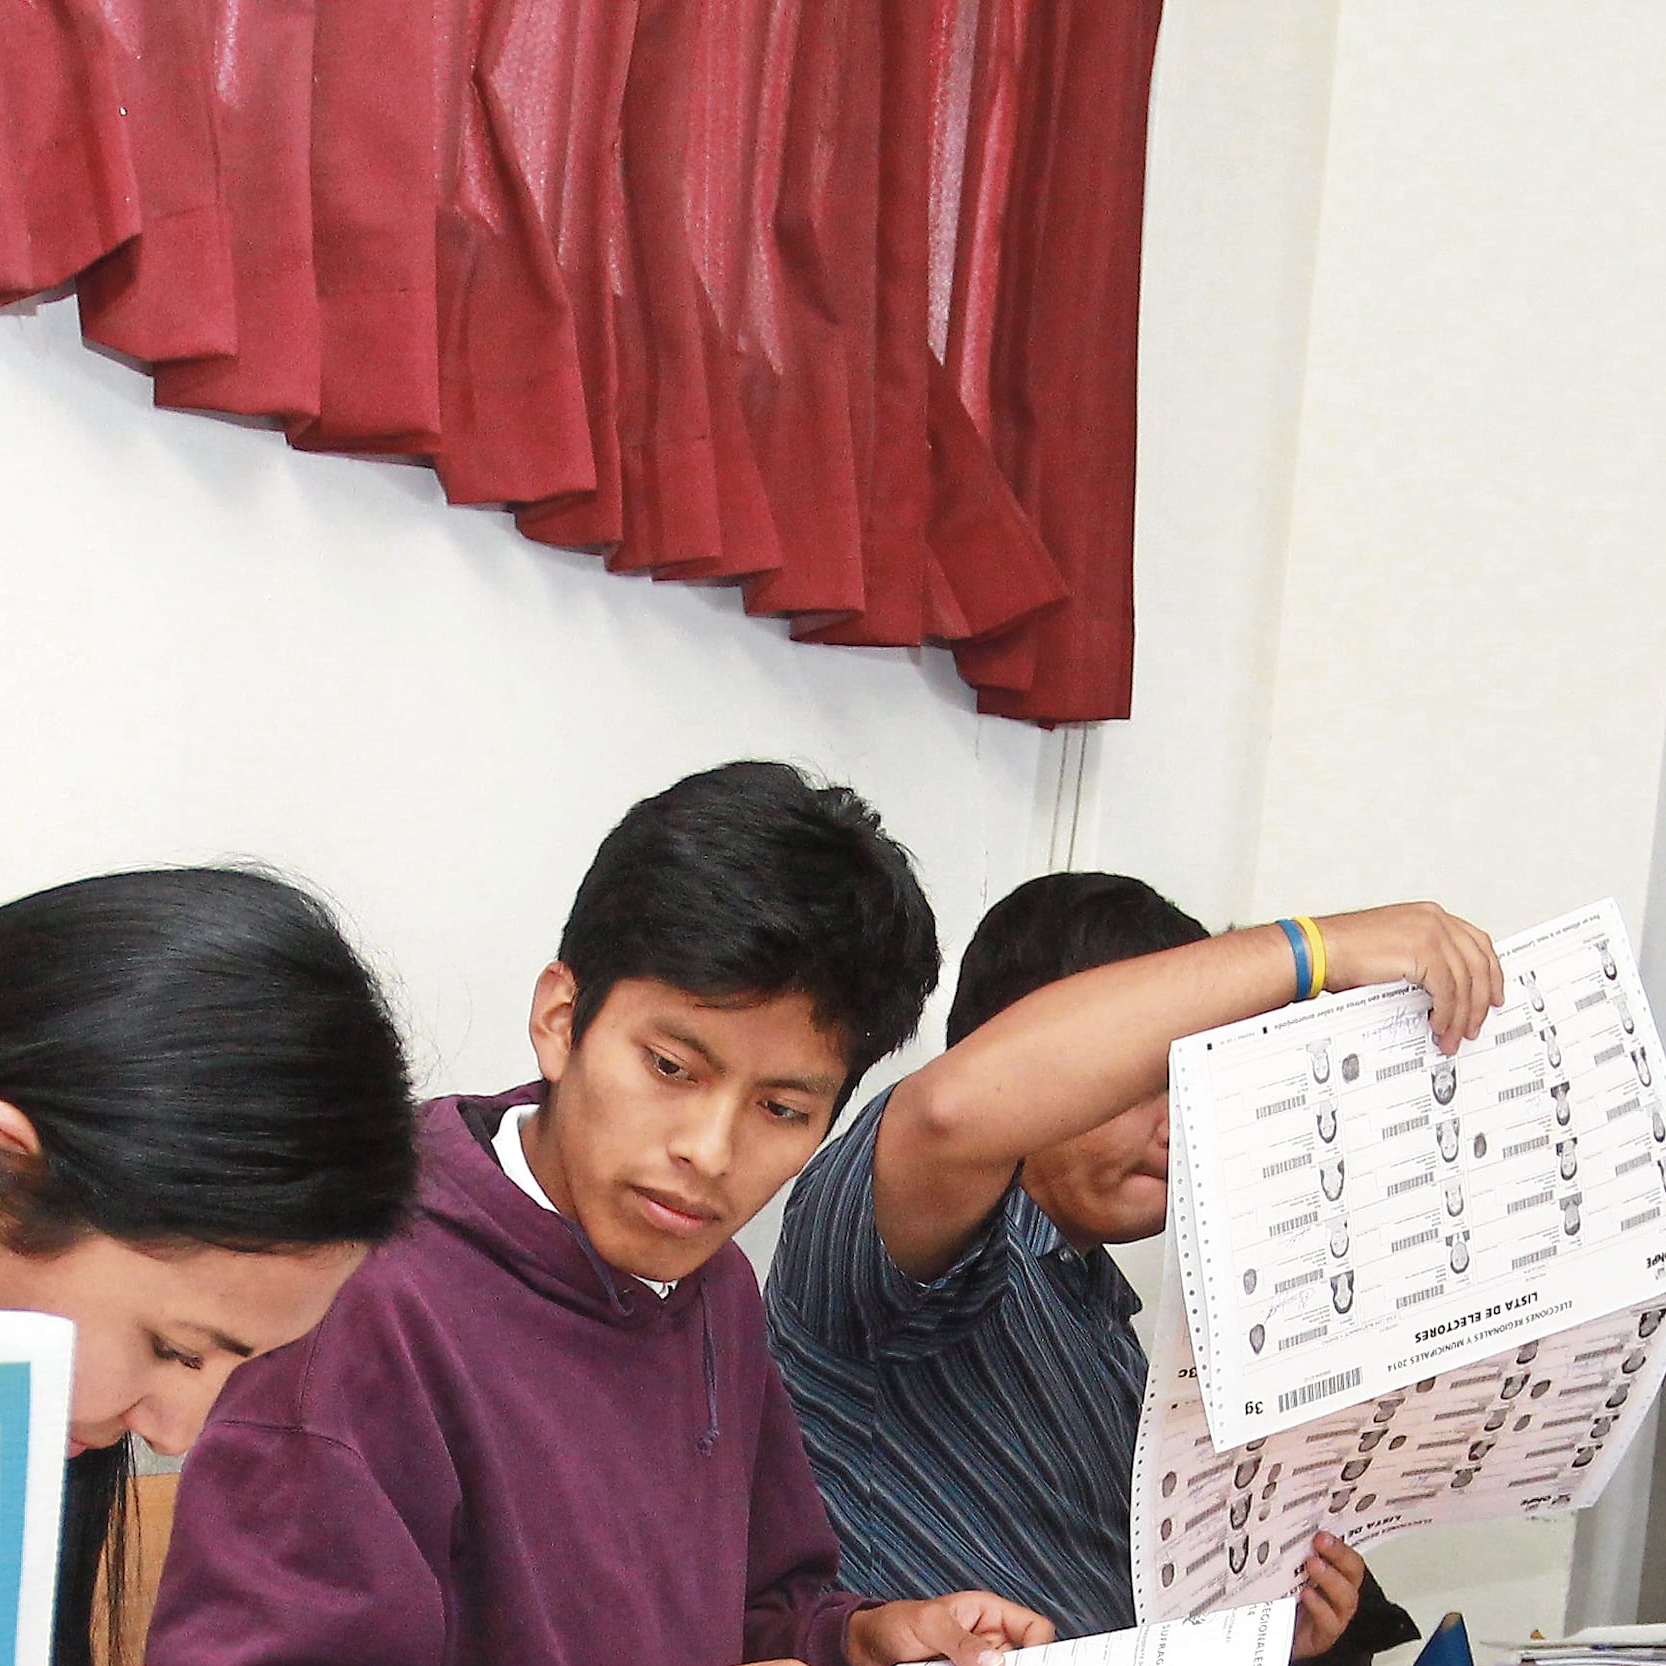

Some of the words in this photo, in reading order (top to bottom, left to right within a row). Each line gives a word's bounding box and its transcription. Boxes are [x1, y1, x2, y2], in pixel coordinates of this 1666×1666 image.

[1505, 1292, 1538, 1311] LISTA
[1485, 1305, 1501, 1321] DE
[1525, 1300, 1573, 1325] ELECCIONES
[1414, 1311, 1482, 1344] ELECTORES
[1473, 1318, 1524, 1341] REGIONALES
[1466, 1336, 1472, 1344] Y
[1410, 1338, 1464, 1365] MUNICIPALES
[1387, 1358, 1408, 1372] 2014
[1244, 1401, 1264, 1416] 3g
